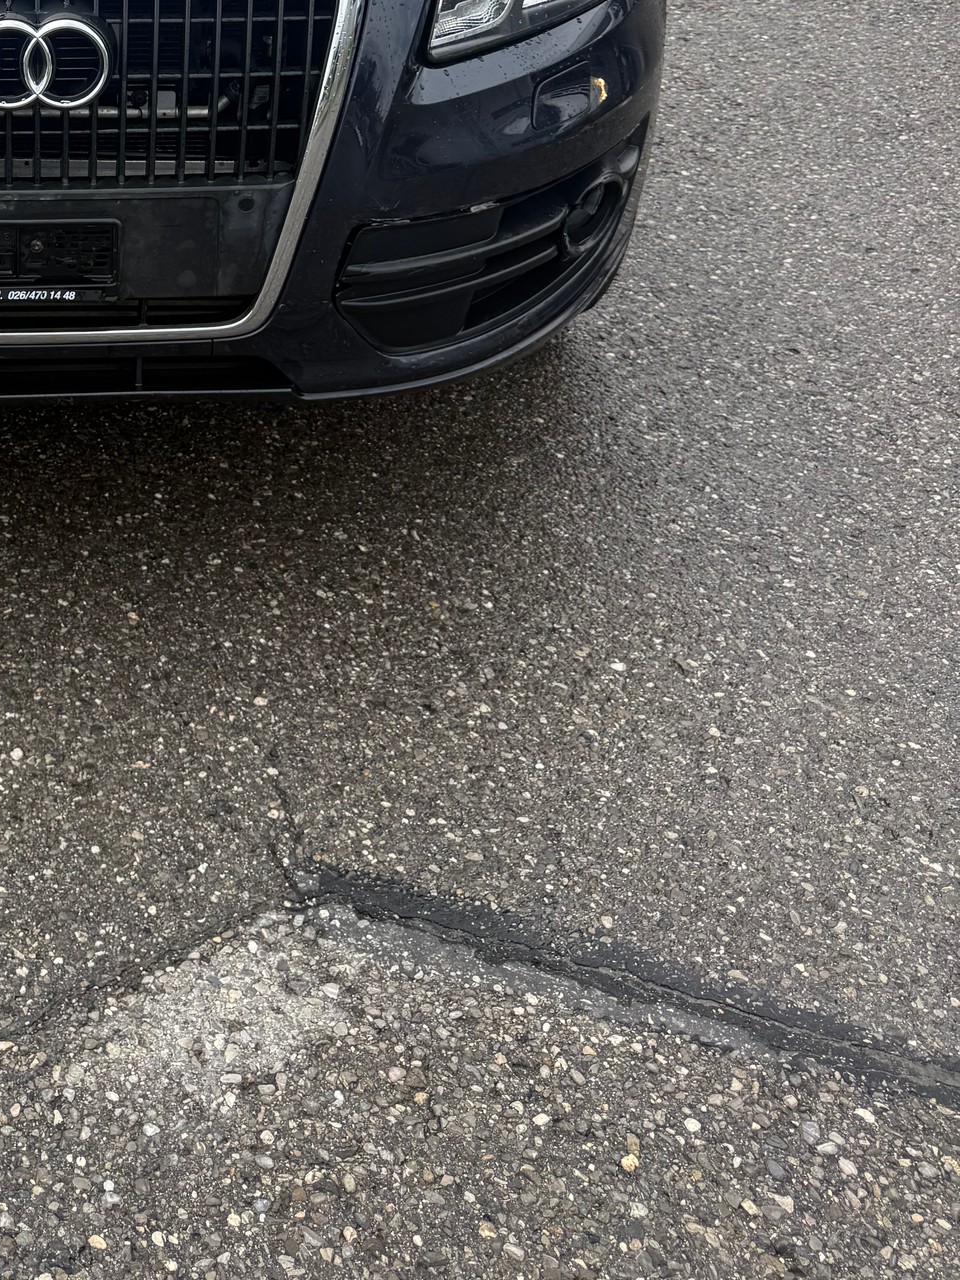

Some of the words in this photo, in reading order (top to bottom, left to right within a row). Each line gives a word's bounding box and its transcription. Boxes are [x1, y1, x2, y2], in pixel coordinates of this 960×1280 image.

[8, 290, 48, 300] 026/470
[50, 290, 62, 300] 14
[62, 291, 76, 301] 48
